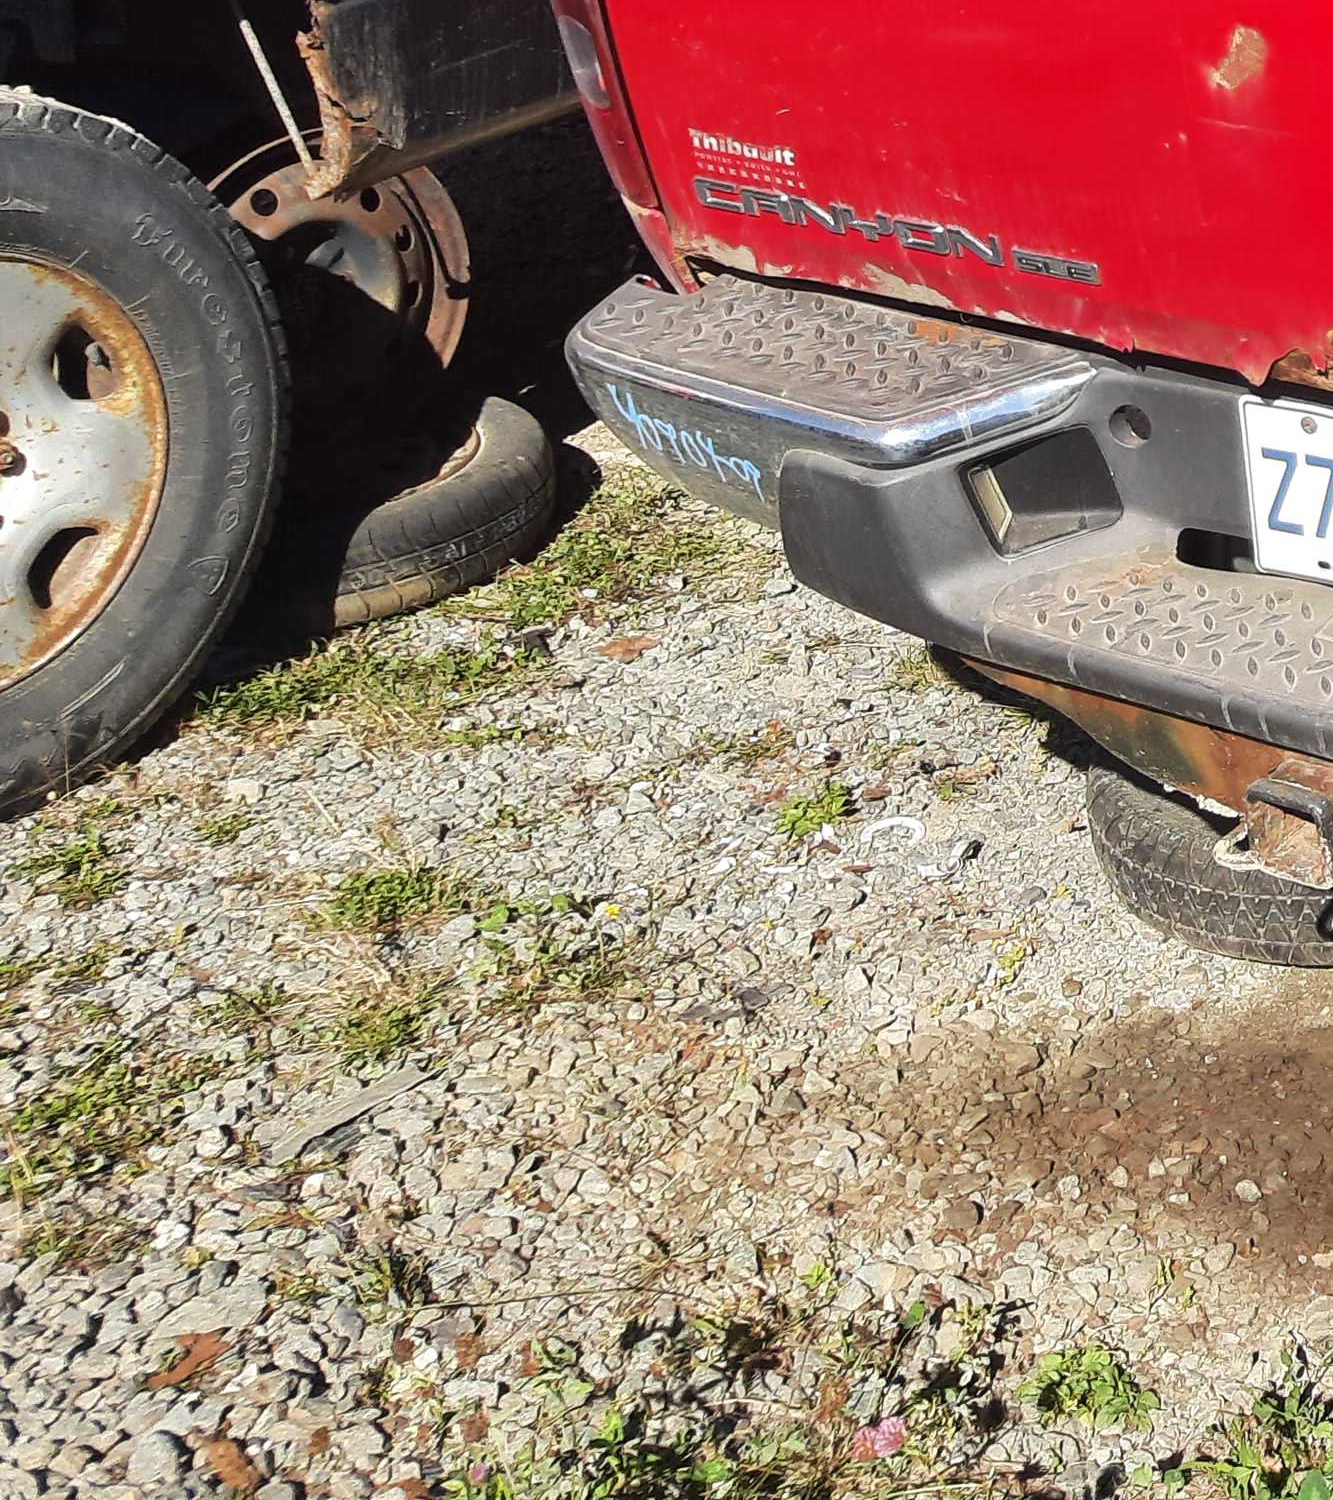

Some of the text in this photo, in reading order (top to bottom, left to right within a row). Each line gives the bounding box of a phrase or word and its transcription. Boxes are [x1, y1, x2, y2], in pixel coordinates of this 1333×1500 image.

[687, 127, 796, 167] Thibault
[694, 177, 1100, 285] CANYON SLE
